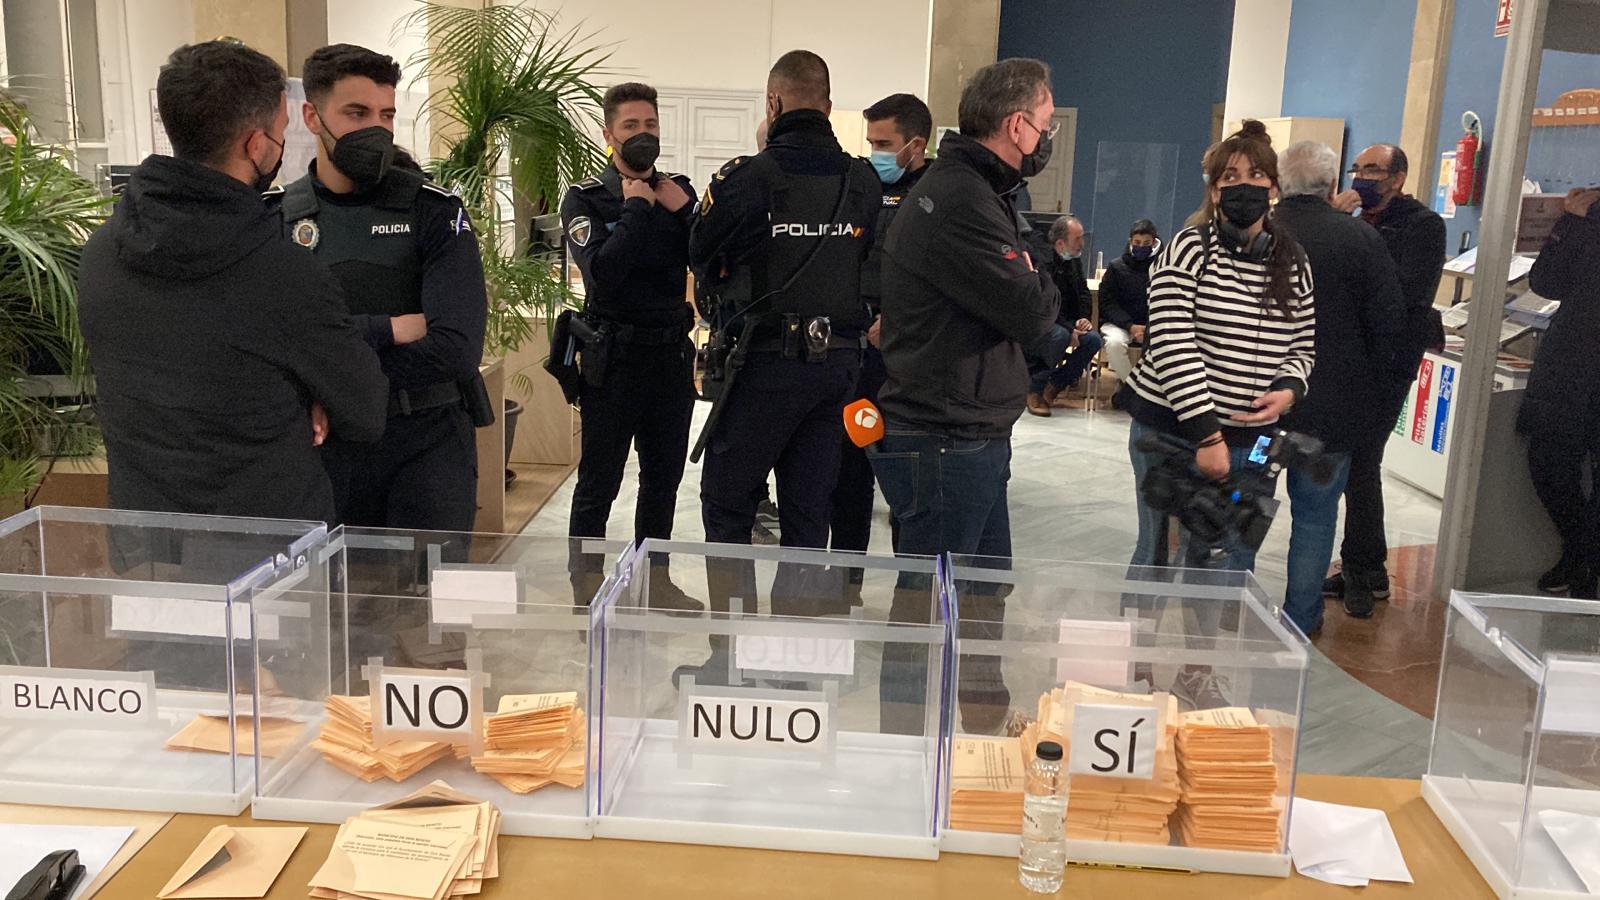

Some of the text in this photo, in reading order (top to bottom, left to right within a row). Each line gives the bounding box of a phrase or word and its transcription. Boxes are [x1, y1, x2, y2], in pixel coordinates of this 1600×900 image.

[371, 223, 410, 234] POLICIA
[14, 683, 142, 714] BLANCO
[385, 682, 469, 729] NO
[693, 703, 821, 743] NULO
[1091, 717, 1146, 774] SÍ
